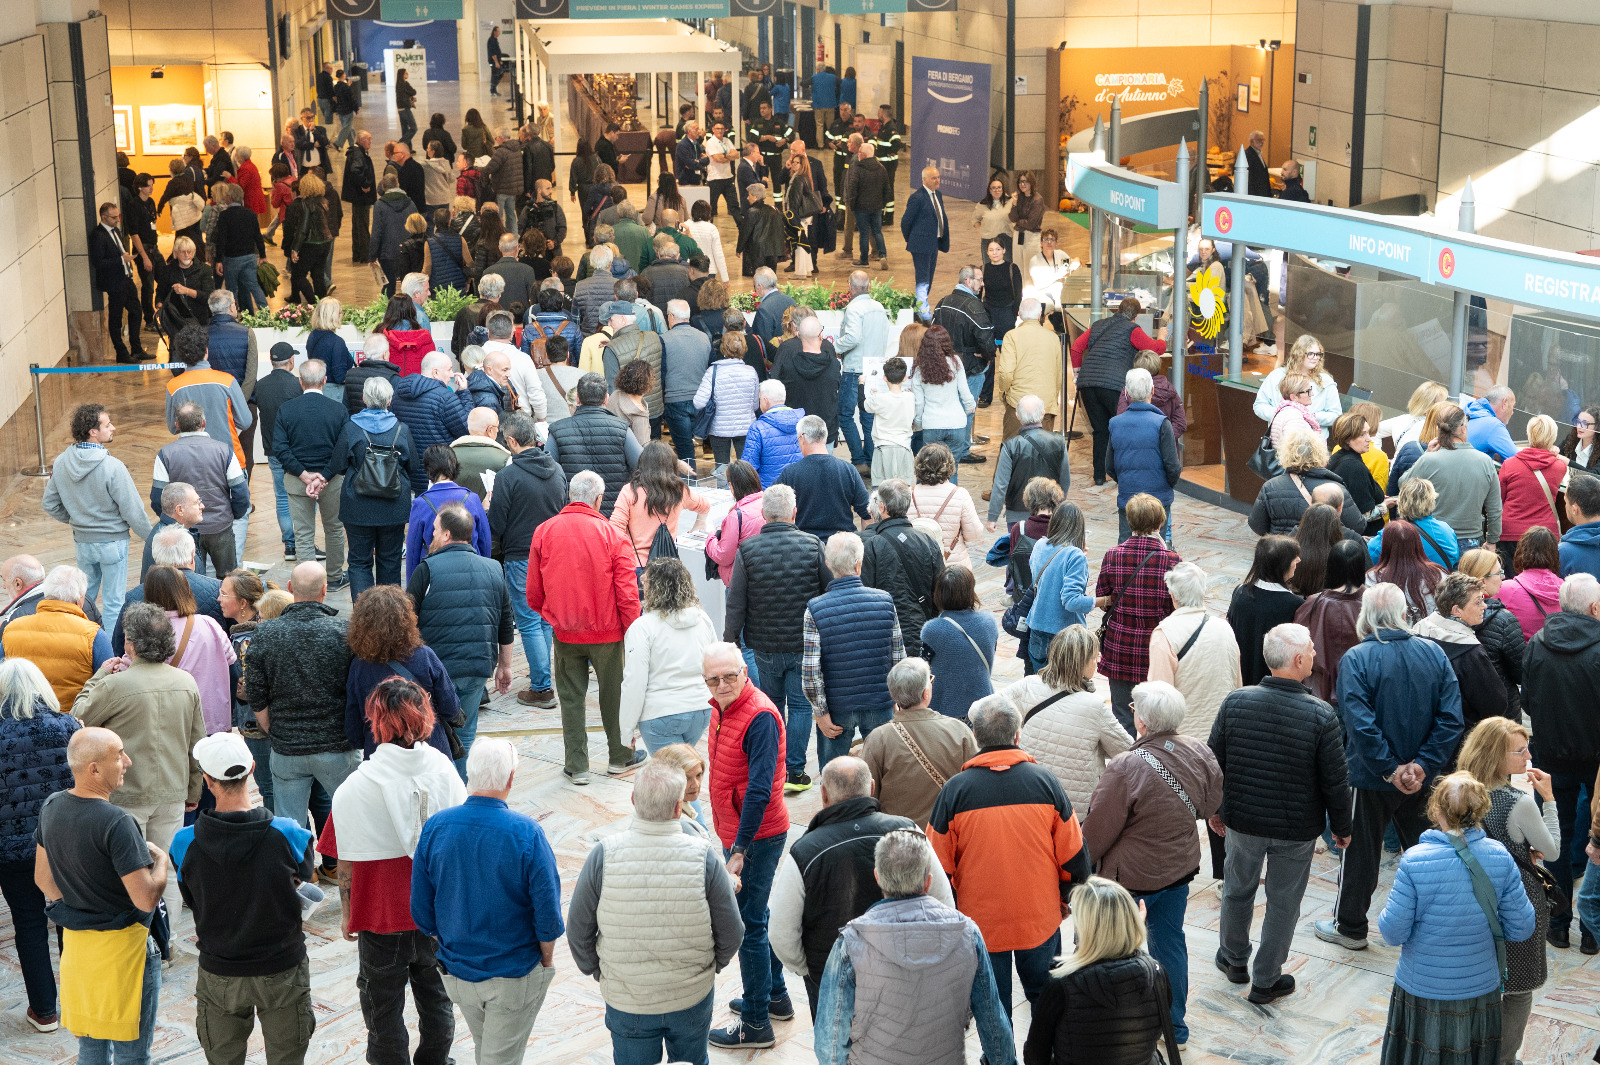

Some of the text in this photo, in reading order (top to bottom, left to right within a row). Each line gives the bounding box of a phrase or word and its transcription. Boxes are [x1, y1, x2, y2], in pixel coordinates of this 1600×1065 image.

[927, 70, 974, 85] FIERA DI BERGAMO
[1095, 72, 1167, 86] CAMPIONARIA
[1110, 189, 1146, 212] INFO POINT
[1349, 234, 1412, 263] INFO POINT
[1195, 341, 1216, 356] FIERA
[1201, 355, 1209, 367] DI
